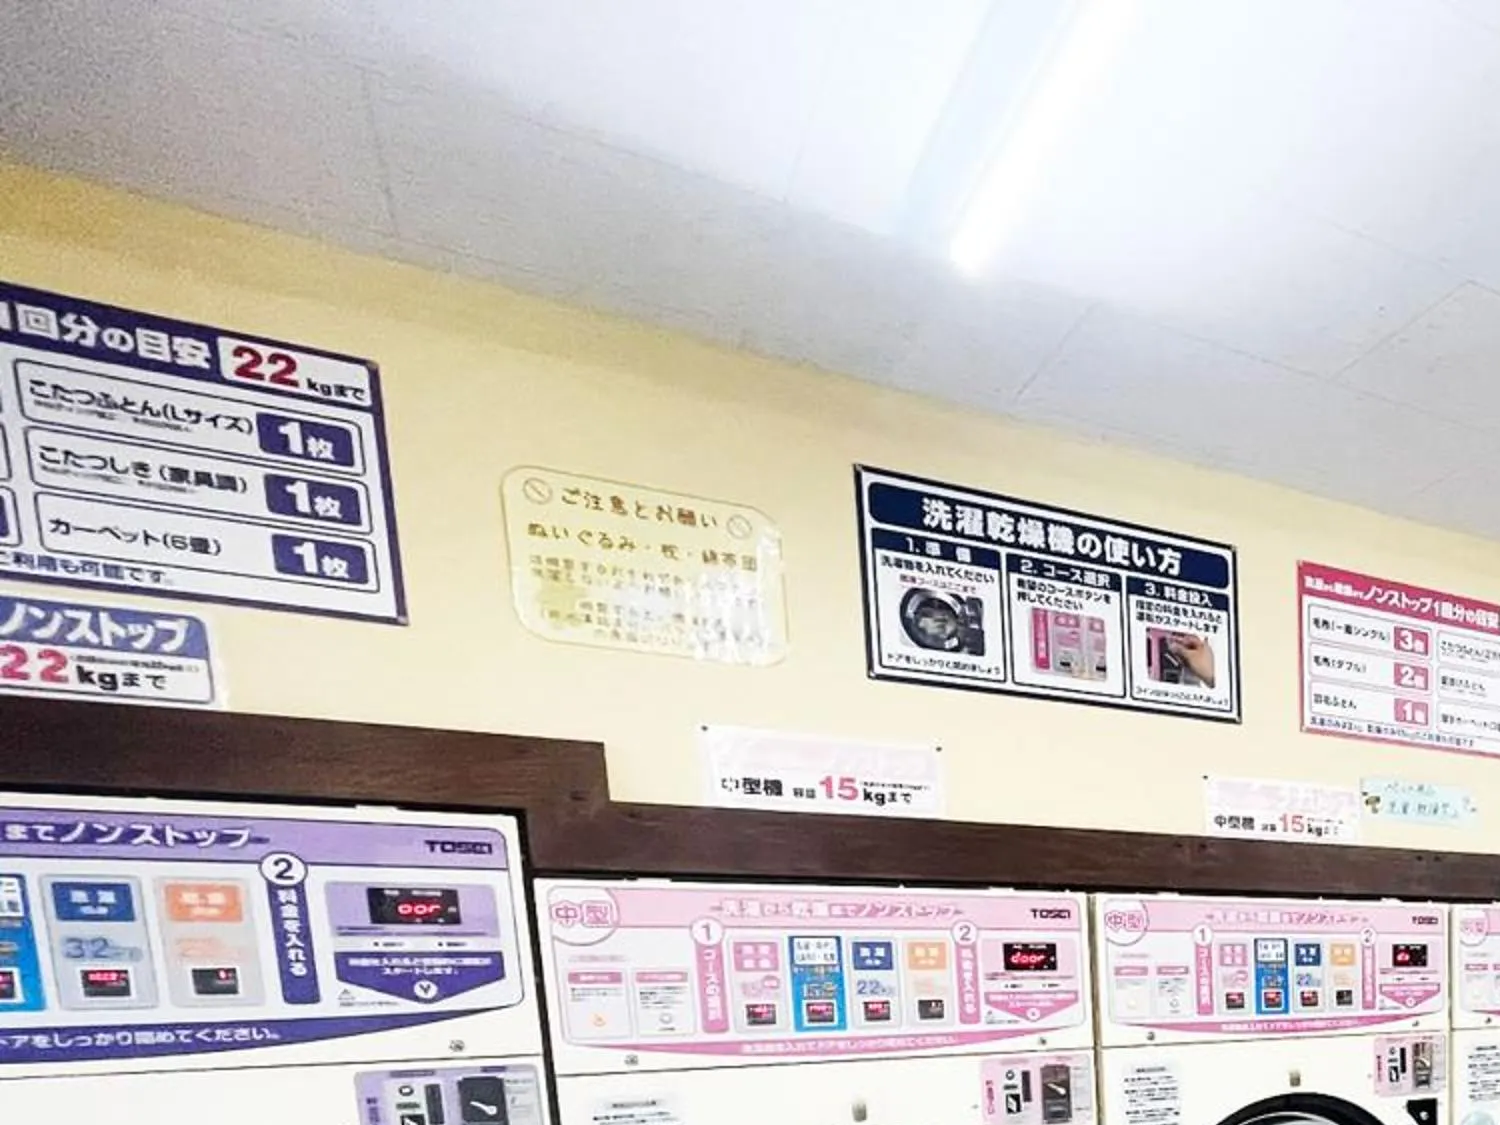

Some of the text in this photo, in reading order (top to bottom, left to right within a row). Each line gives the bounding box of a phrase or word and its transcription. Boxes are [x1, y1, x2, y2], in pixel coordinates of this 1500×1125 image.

[921, 497, 1182, 577] 洗濯乾燥機の使い方
[424, 839, 493, 855] TOSEI
[272, 858, 295, 881] 2
[1030, 908, 1071, 919] TOSEI
